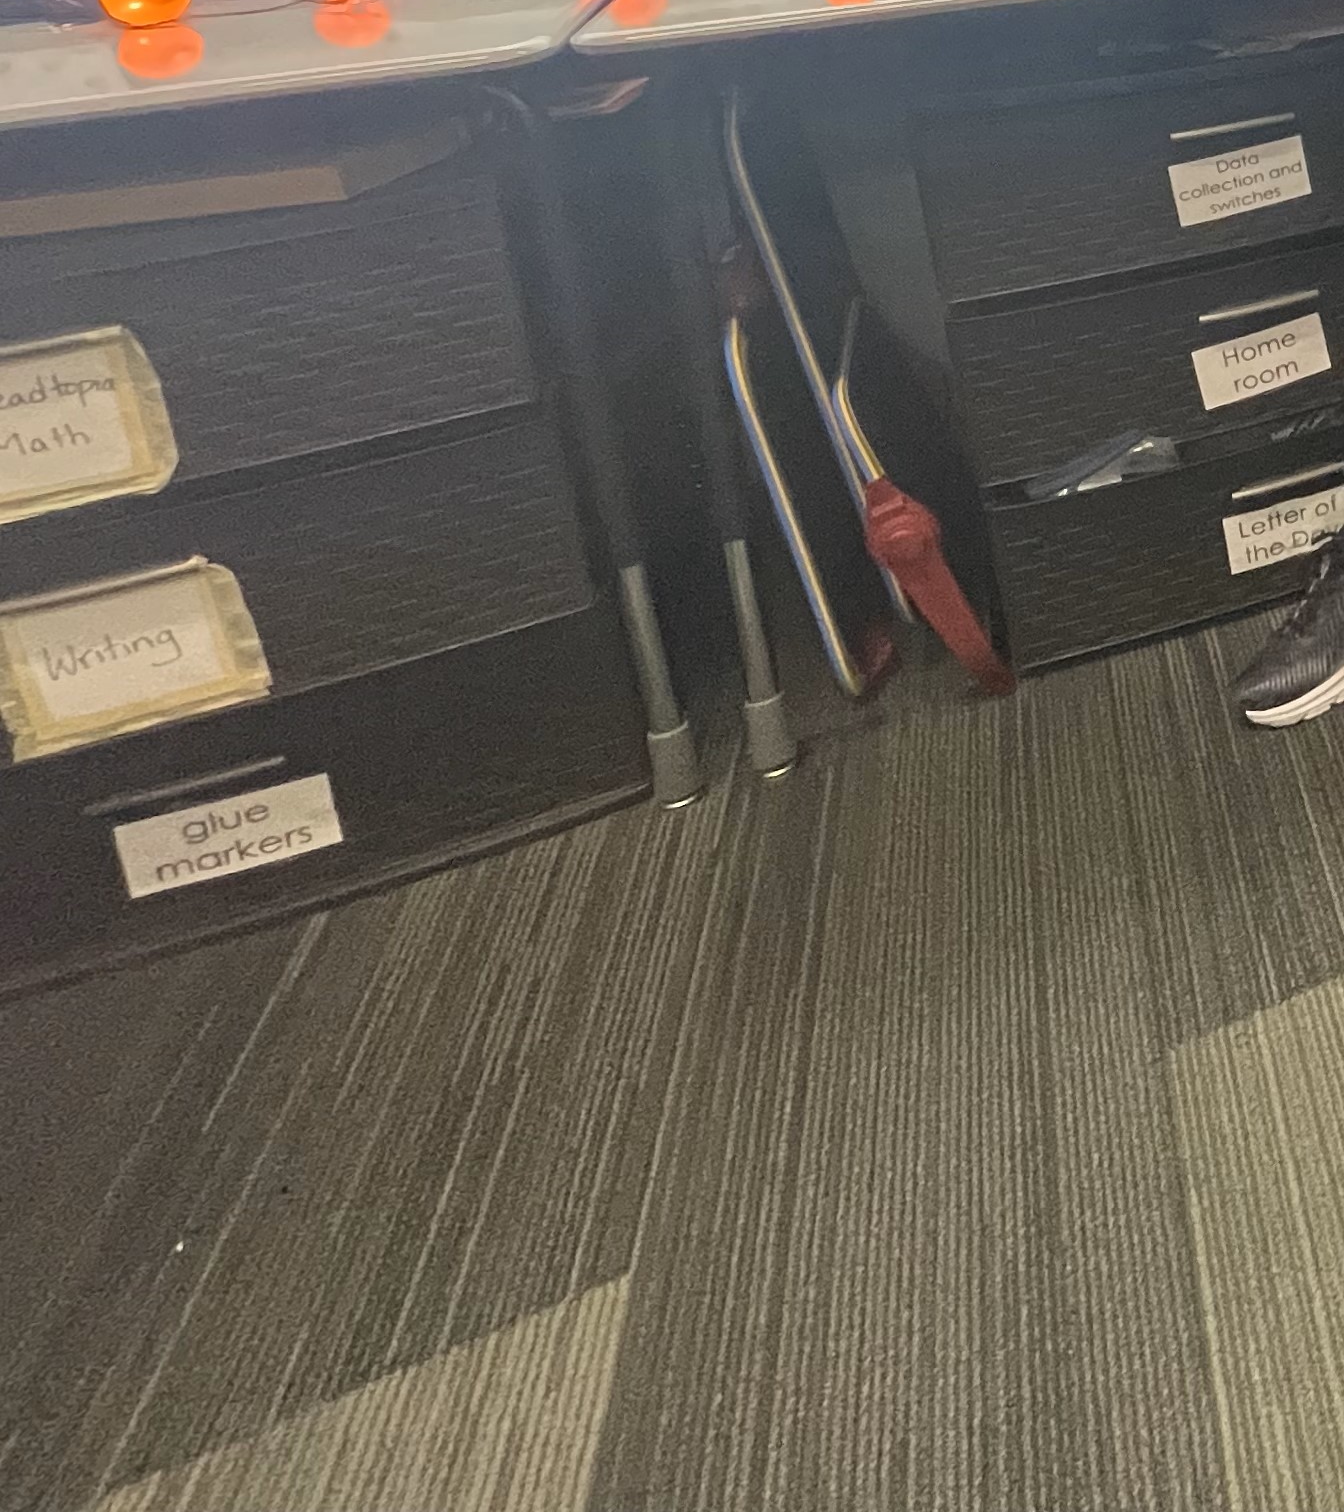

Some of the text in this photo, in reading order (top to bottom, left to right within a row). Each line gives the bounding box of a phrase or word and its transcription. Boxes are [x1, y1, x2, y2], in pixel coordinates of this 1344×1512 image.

[1178, 160, 1304, 202] collection and
[1215, 153, 1261, 174] Data
[1209, 186, 1282, 215] switches
[1222, 333, 1297, 368] Home
[1233, 360, 1300, 394] room
[1238, 494, 1338, 539] Letter of
[1245, 540, 1286, 565] the
[41, 626, 183, 684] Writing
[181, 797, 271, 846] glue
[154, 822, 314, 884] markers
